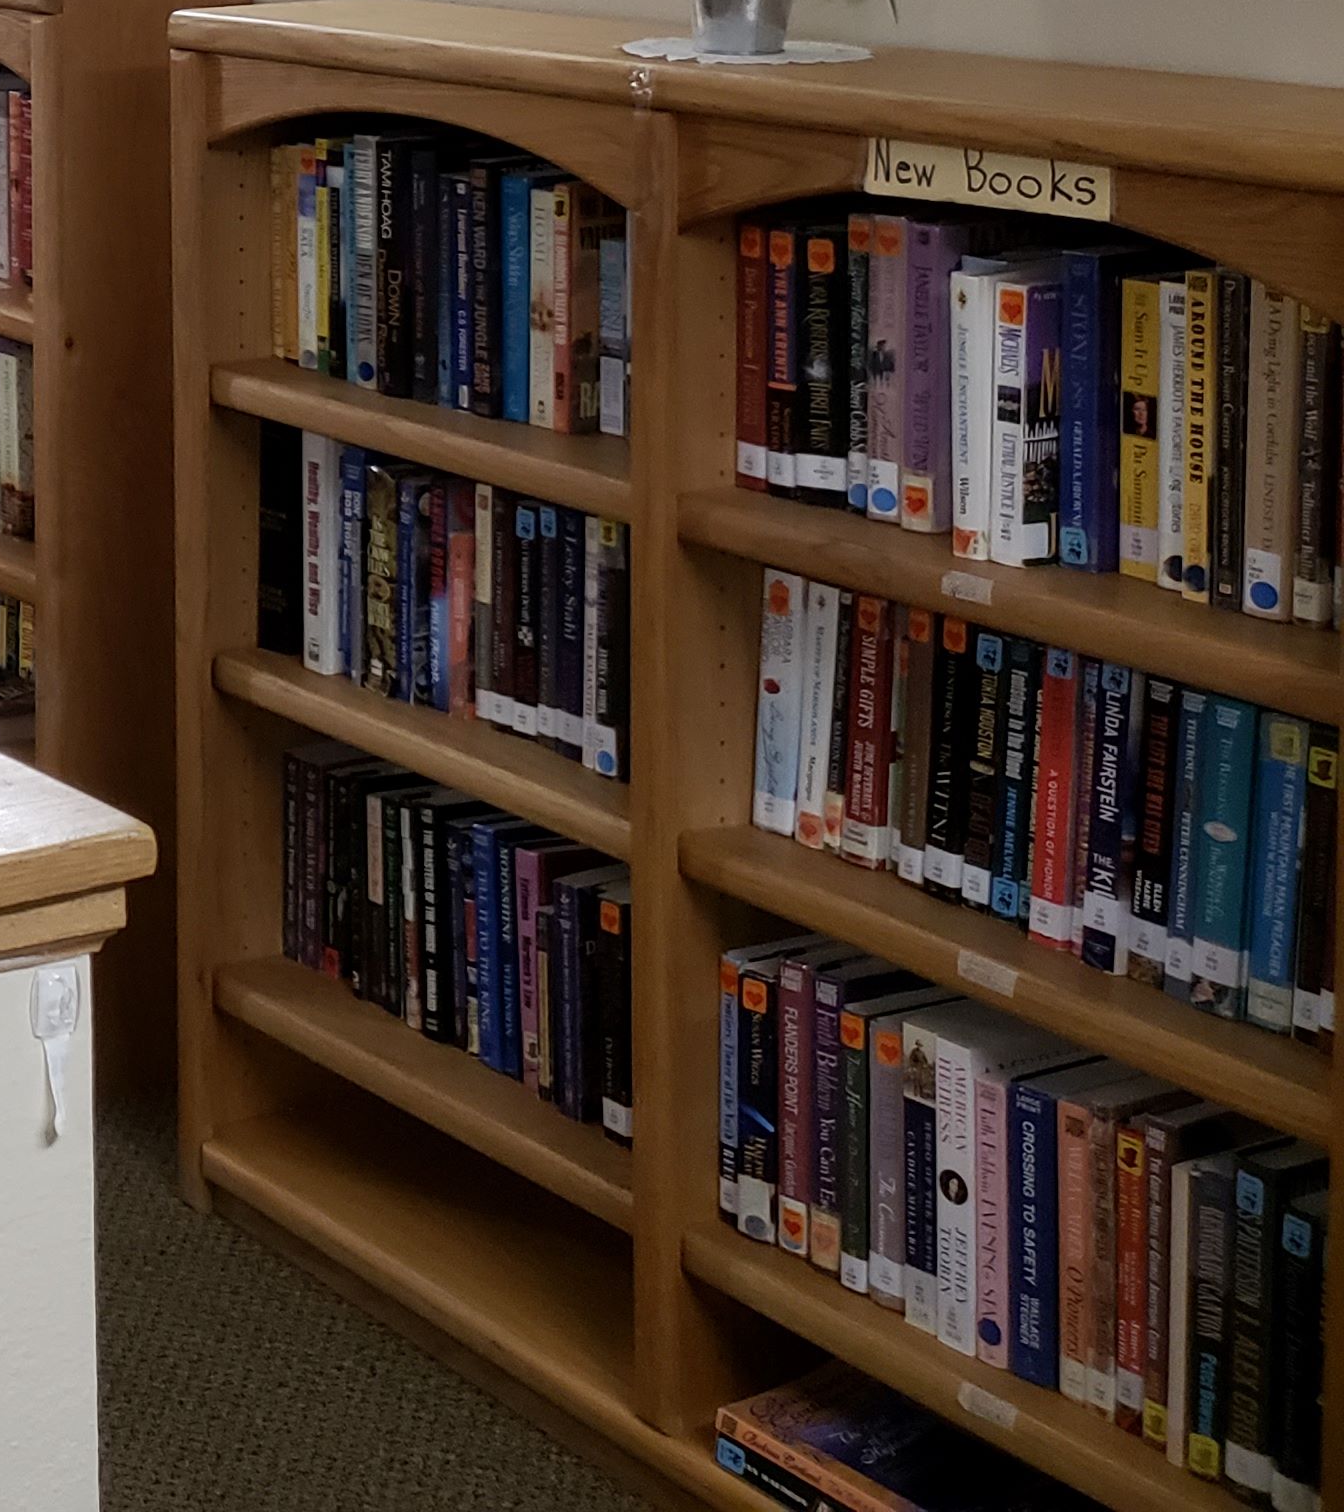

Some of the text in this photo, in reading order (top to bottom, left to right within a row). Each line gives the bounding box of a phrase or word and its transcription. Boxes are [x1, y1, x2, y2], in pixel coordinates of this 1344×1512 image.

[381, 150, 392, 239] TAMI HOAG
[874, 137, 1096, 205] New Books
[355, 149, 373, 345] TERRY ANDERSON DEN OF LIONS
[387, 270, 401, 327] DOWN
[473, 191, 488, 358] KEN WARD JUNGLE
[1269, 305, 1280, 314] A
[914, 322, 932, 373] TAYLOR
[998, 325, 1021, 376] MICHAELS
[1170, 324, 1185, 357] JAMES
[1264, 319, 1280, 356] Dying
[1128, 365, 1145, 386] Up
[1190, 298, 1204, 484] AROUND THE HOUSE
[1303, 358, 1318, 440] and the Wolf
[958, 324, 969, 514] JUNGLE ENCHANTMENT Wilson
[1001, 470, 1017, 510] JUSTICE
[307, 461, 320, 616] Healthy, Wealthy, and Wise
[344, 490, 353, 557] BOB HOPE
[562, 536, 578, 640] Lesley Stahl
[858, 635, 876, 729] SIMPLE GIFTS
[831, 721, 842, 760] MARION
[854, 740, 864, 771] JUDITH
[977, 708, 995, 758] HOUSTON
[1096, 691, 1124, 822] LINDA FAIRSTEIN
[1184, 719, 1196, 780] THE TROUT
[1006, 750, 1024, 780] Blood
[1006, 787, 1018, 828] JENNIE
[1046, 781, 1056, 836] QUESTION
[1282, 784, 1294, 814] FIRST
[422, 830, 434, 846] THE
[1045, 840, 1054, 855] OF
[1093, 853, 1115, 870] THE
[1276, 816, 1292, 882] MOUNTAIN
[423, 848, 434, 890] MASTERS
[499, 846, 512, 944] MOONSHINE
[1043, 858, 1054, 899] HONOR
[1133, 870, 1143, 913] WISEMAN
[1144, 880, 1153, 908] MARIE
[1176, 811, 1192, 930] PETER CUNNINGHAM
[424, 906, 436, 922] THE
[478, 910, 488, 922] IT
[1152, 883, 1163, 912] ELLEN
[479, 930, 489, 951] TO
[1268, 920, 1284, 977] PREACHER
[480, 956, 490, 988] THE
[480, 992, 490, 1030] KING
[750, 1012, 763, 1085] SUSAN WIGGS
[784, 1006, 798, 1074] FLANDERS
[784, 1076, 798, 1115] POINT
[816, 1051, 838, 1112] Baldwin
[938, 1057, 952, 1144] HEIRESS
[819, 1118, 836, 1140] You
[954, 1064, 967, 1154] AMERICAN
[819, 1146, 836, 1182] Can't
[907, 1130, 916, 1256] CANDICE MILLARD
[1022, 1121, 1036, 1285] CROSSING TO SAFETY
[940, 1226, 951, 1294] TOOBIN
[954, 1226, 967, 1306] JEFFREY
[1197, 1206, 1224, 1342] RENEGADE CANYON
[1020, 1293, 1030, 1344] STEGNER
[1028, 1298, 1040, 1349] WALLACE
[1066, 1284, 1084, 1365] Pioneers!
[1235, 1223, 1261, 1391] PATTERSON ALEX
